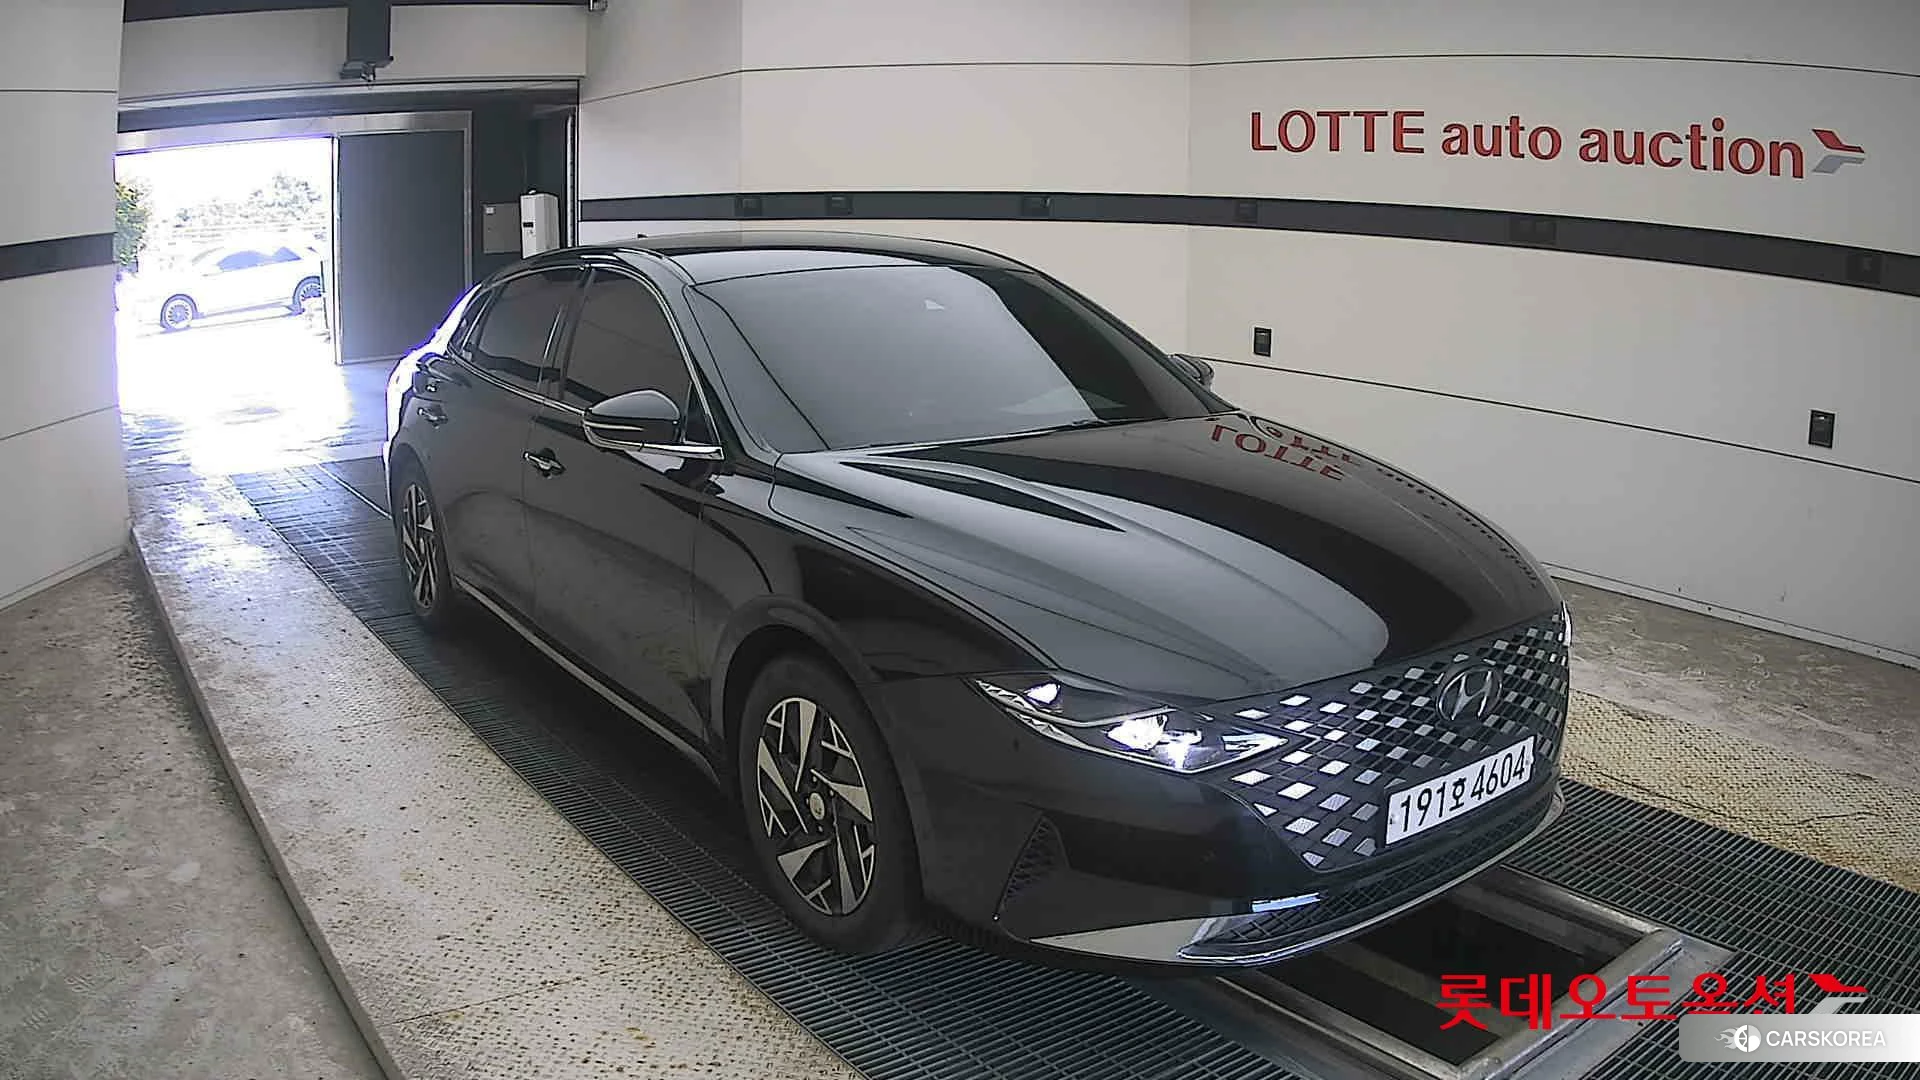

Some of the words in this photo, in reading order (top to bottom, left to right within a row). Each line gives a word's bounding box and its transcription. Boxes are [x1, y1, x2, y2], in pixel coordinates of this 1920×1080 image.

[1251, 110, 1425, 154] LOTTE
[1440, 115, 1563, 161] auto
[1578, 117, 1805, 179] auction
[1400, 777, 1467, 833] 191호
[1470, 745, 1527, 802] 4604
